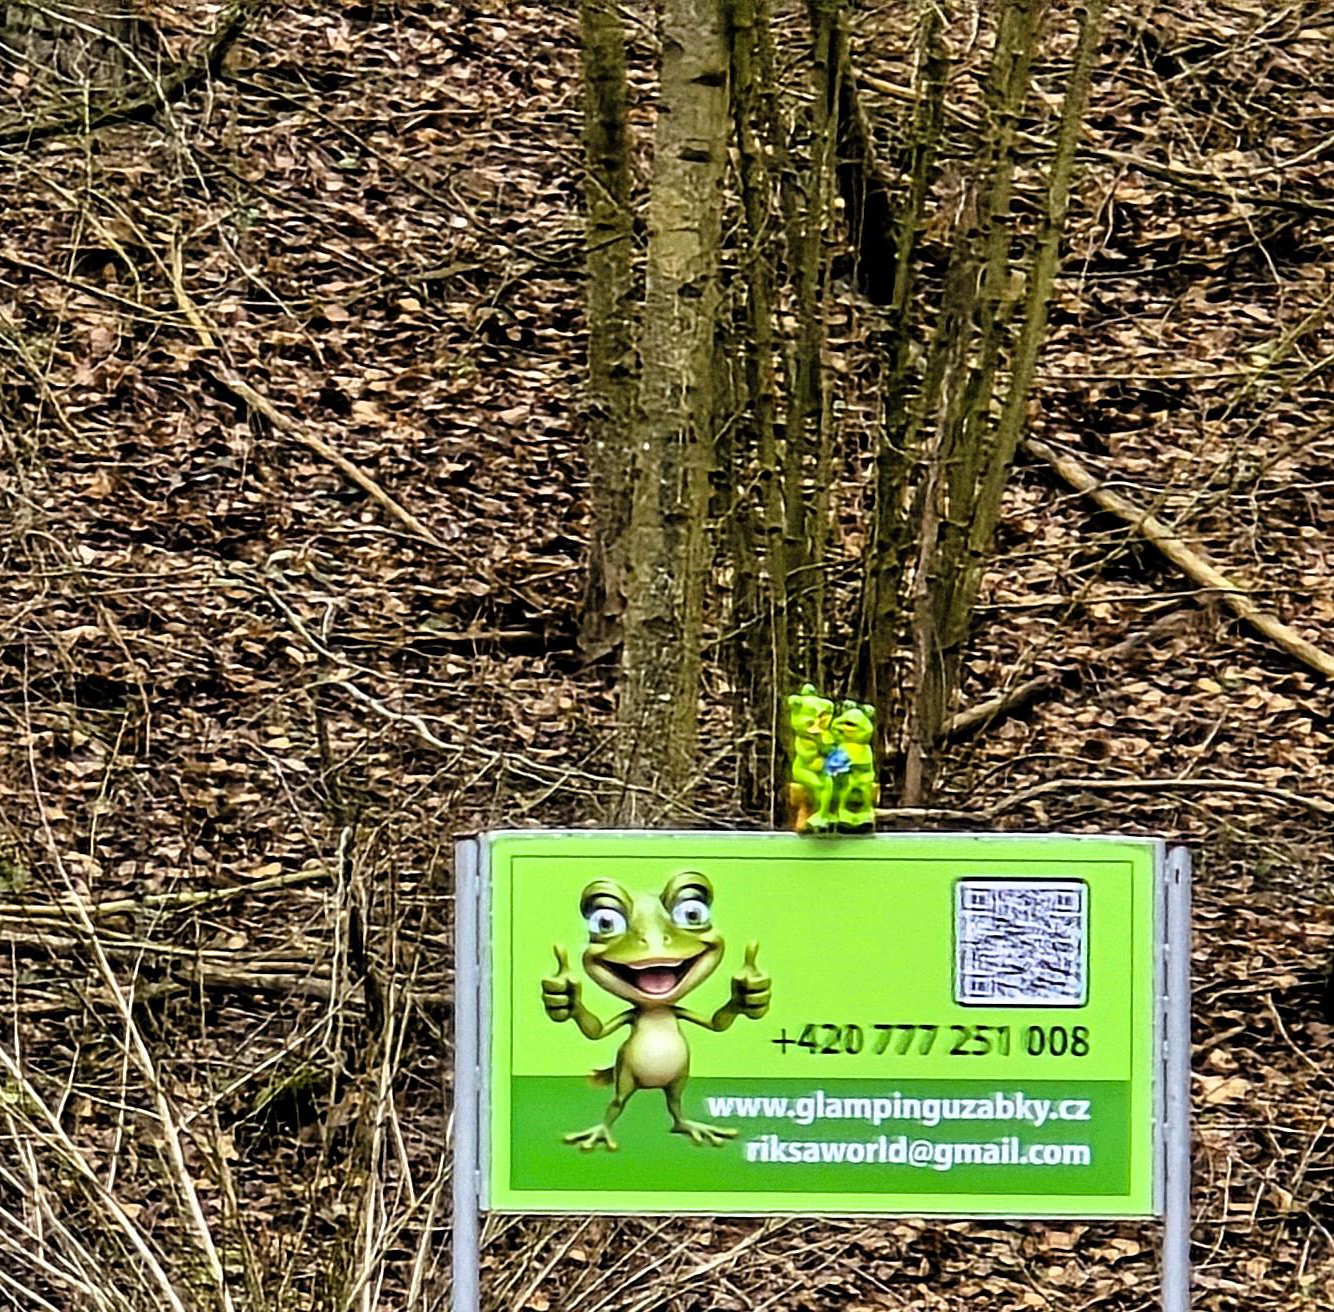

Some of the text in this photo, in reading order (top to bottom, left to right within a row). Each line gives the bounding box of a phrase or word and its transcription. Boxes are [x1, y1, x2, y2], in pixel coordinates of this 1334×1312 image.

[771, 1024, 1090, 1056] +420 777 251 008
[708, 1090, 1091, 1125] www.glampinguzabky.cz
[746, 1134, 1091, 1171] riksaworld@gmail.com
